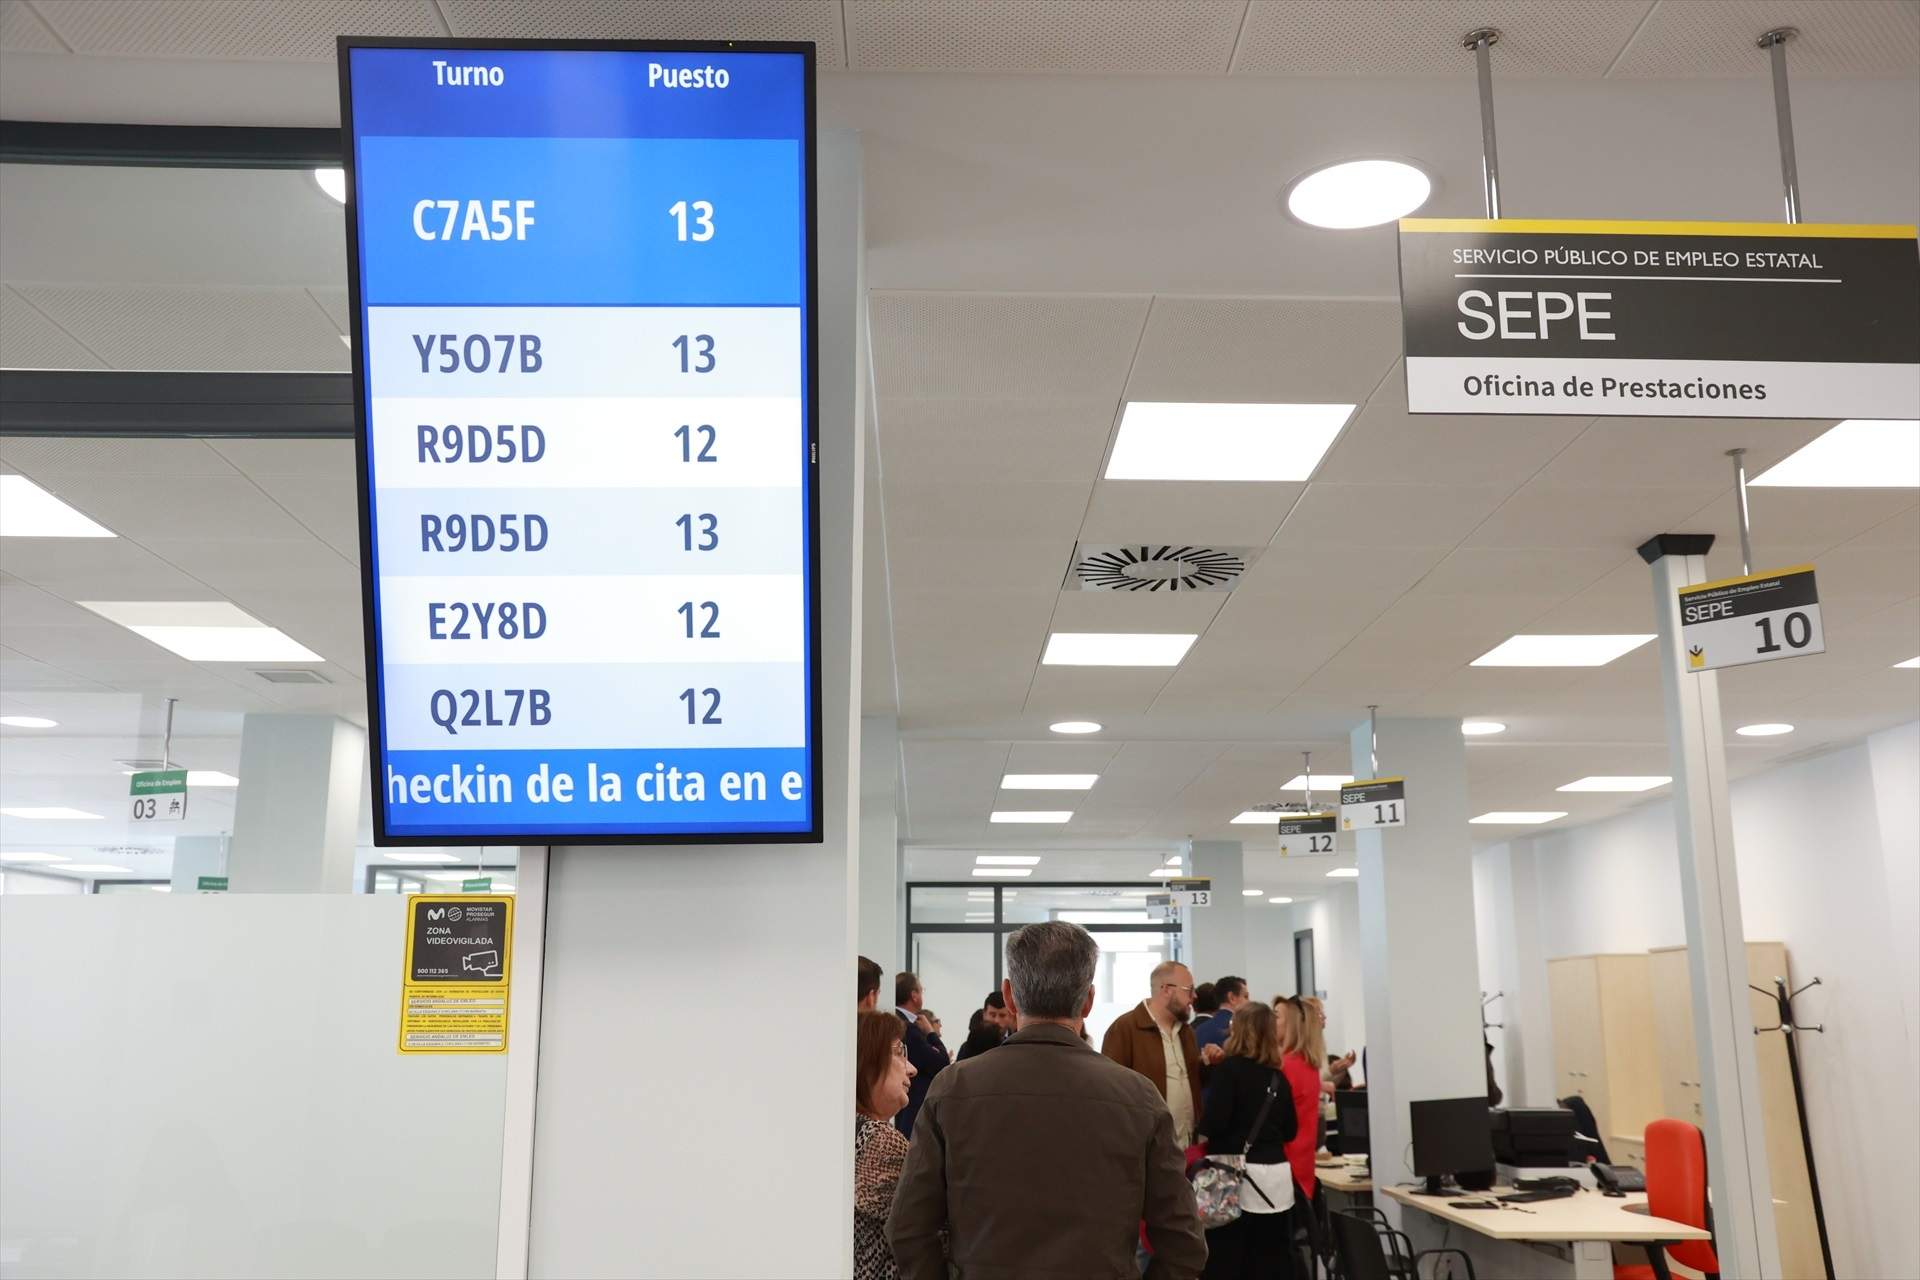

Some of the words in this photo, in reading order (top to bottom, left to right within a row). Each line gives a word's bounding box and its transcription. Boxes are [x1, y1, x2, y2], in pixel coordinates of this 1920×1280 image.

[433, 60, 505, 87] Turno
[648, 63, 730, 89] Puesto
[412, 199, 536, 241] C7A5F
[668, 200, 715, 242] 13
[1453, 247, 1538, 265] SERVICIO
[1544, 245, 1627, 266] PÚBLICO
[1634, 250, 1660, 267] DE
[1666, 251, 1740, 268] EMPLEO
[1746, 252, 1824, 269] ESTATAL
[1456, 289, 1617, 342] SEPE
[671, 334, 717, 375] 13
[1463, 374, 1555, 398] Oficina
[1563, 374, 1594, 398] de
[1602, 376, 1767, 401] Prestaciones
[416, 424, 547, 464] R9D5D
[673, 424, 718, 463] 12
[420, 514, 549, 552] R9D5D
[675, 513, 720, 551] 13
[428, 601, 548, 640] E2Y8D
[677, 601, 721, 639] 12
[1685, 599, 1735, 623] SEPE
[1754, 611, 1812, 654] 10
[429, 689, 553, 735] Q2L7B
[679, 687, 723, 725] 12
[526, 763, 575, 804] de
[588, 763, 623, 803] la
[636, 762, 706, 802] cita
[719, 769, 767, 802] en
[780, 769, 803, 802] e
[133, 798, 157, 819] 03
[1342, 792, 1366, 804] SEPE
[1374, 803, 1400, 824] 11
[1280, 824, 1301, 834] SEPE
[1309, 835, 1333, 853] 12
[1191, 892, 1208, 905] 13
[1164, 906, 1178, 917] 14
[426, 927, 451, 935] ZONA
[426, 937, 494, 945] VIDEOVIGILADA
